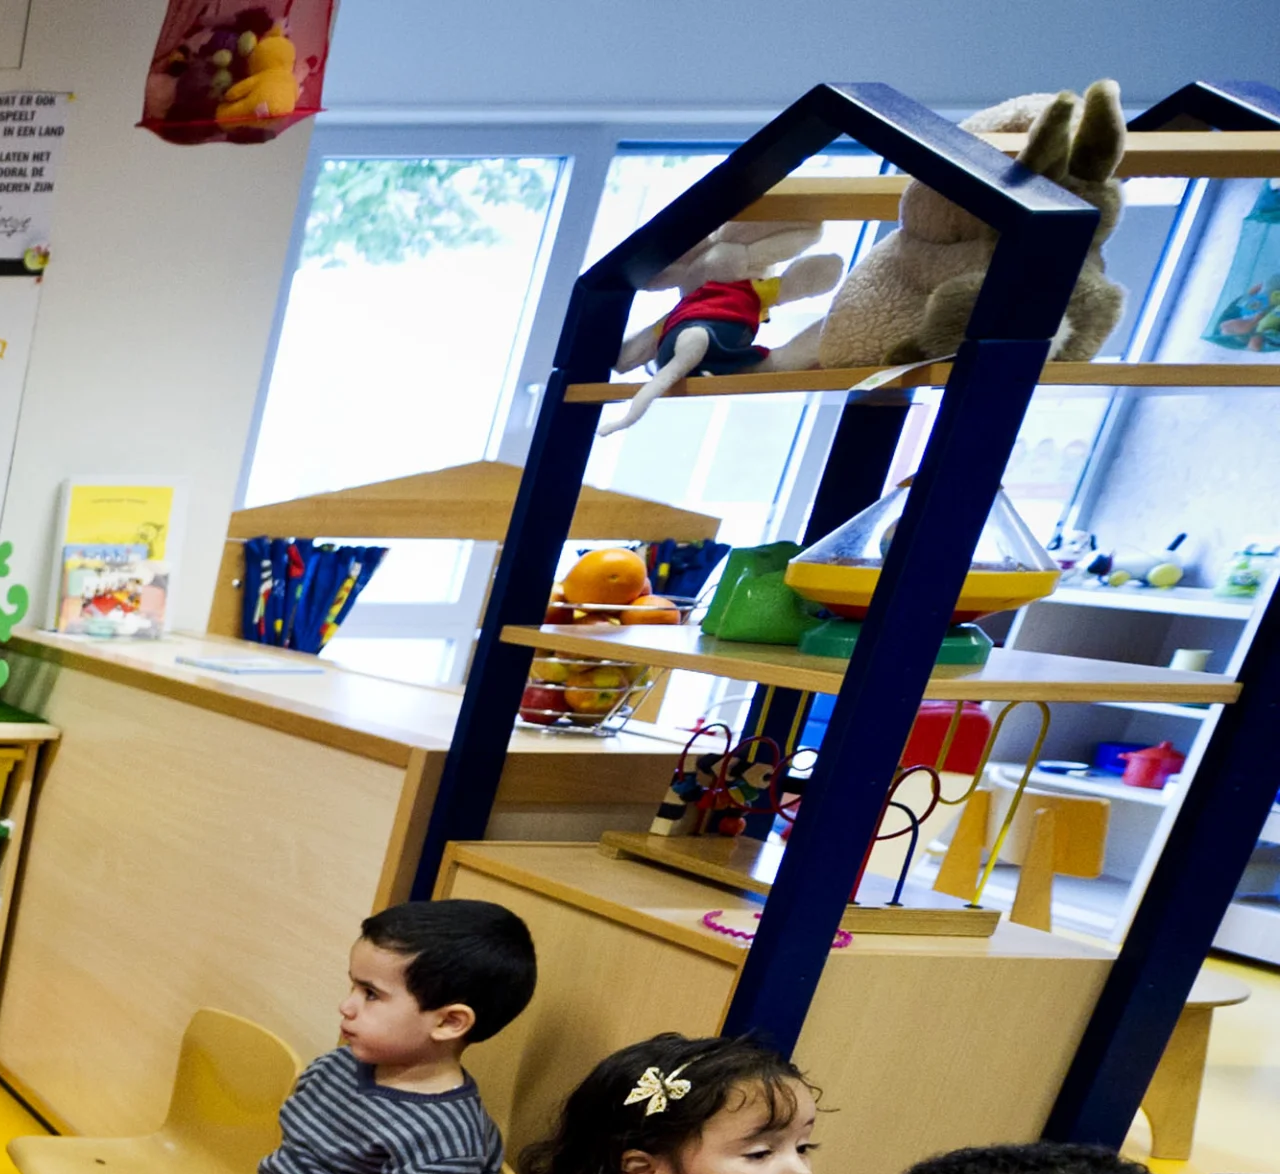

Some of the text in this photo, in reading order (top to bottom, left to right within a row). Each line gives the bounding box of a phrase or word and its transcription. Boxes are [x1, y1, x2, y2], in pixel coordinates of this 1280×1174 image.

[19, 95, 33, 106] ER
[35, 95, 56, 106] OOK
[0, 110, 36, 122] SPEELT
[3, 126, 65, 137] IN EEN LAND
[0, 151, 51, 162] LATEN HET
[31, 167, 44, 177] DE
